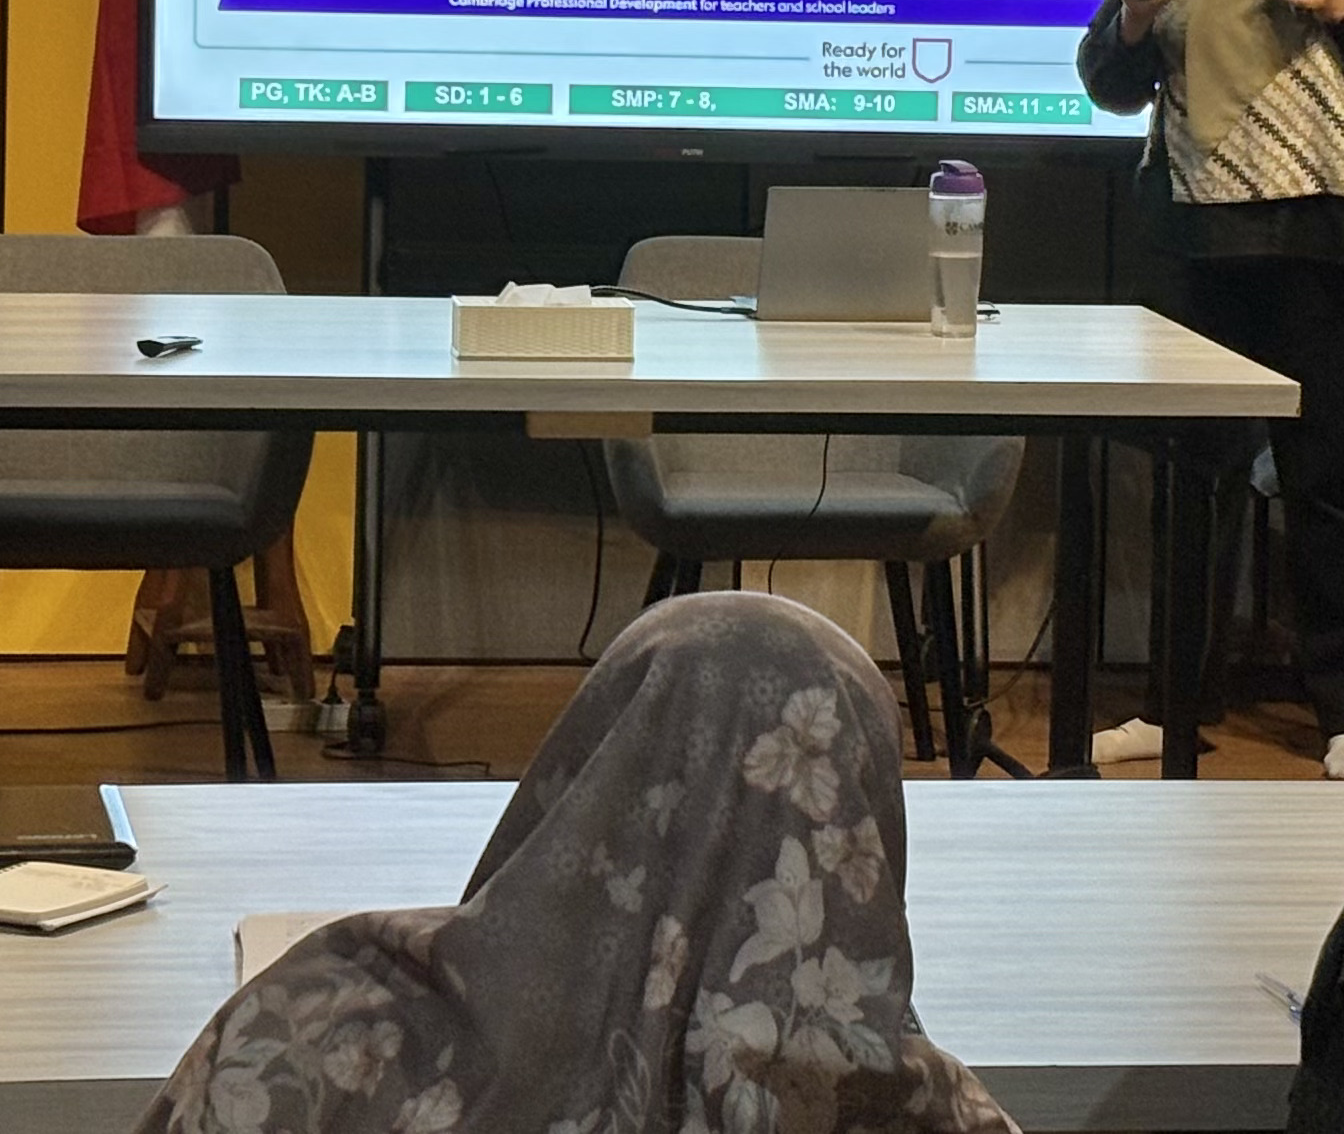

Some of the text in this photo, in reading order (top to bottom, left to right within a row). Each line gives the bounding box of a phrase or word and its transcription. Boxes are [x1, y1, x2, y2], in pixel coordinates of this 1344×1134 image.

[700, 0, 717, 13] for
[720, 0, 776, 15] teachers
[777, 0, 803, 15] and
[805, 1, 846, 15] school
[847, 2, 896, 16] leaders
[822, 42, 905, 61] Ready for
[823, 62, 905, 79] the world
[251, 83, 377, 104] PG, TK: A-B
[435, 86, 473, 105] SD:
[480, 88, 489, 105] 1
[511, 88, 523, 106] 6
[611, 90, 663, 108] SMP:
[669, 93, 681, 110] 7
[698, 93, 717, 112] 8,
[784, 93, 836, 111] SMA:
[854, 95, 896, 113] 9-10
[964, 97, 1014, 114] SMA:
[1019, 99, 1041, 116] 11
[1056, 99, 1080, 116] 12
